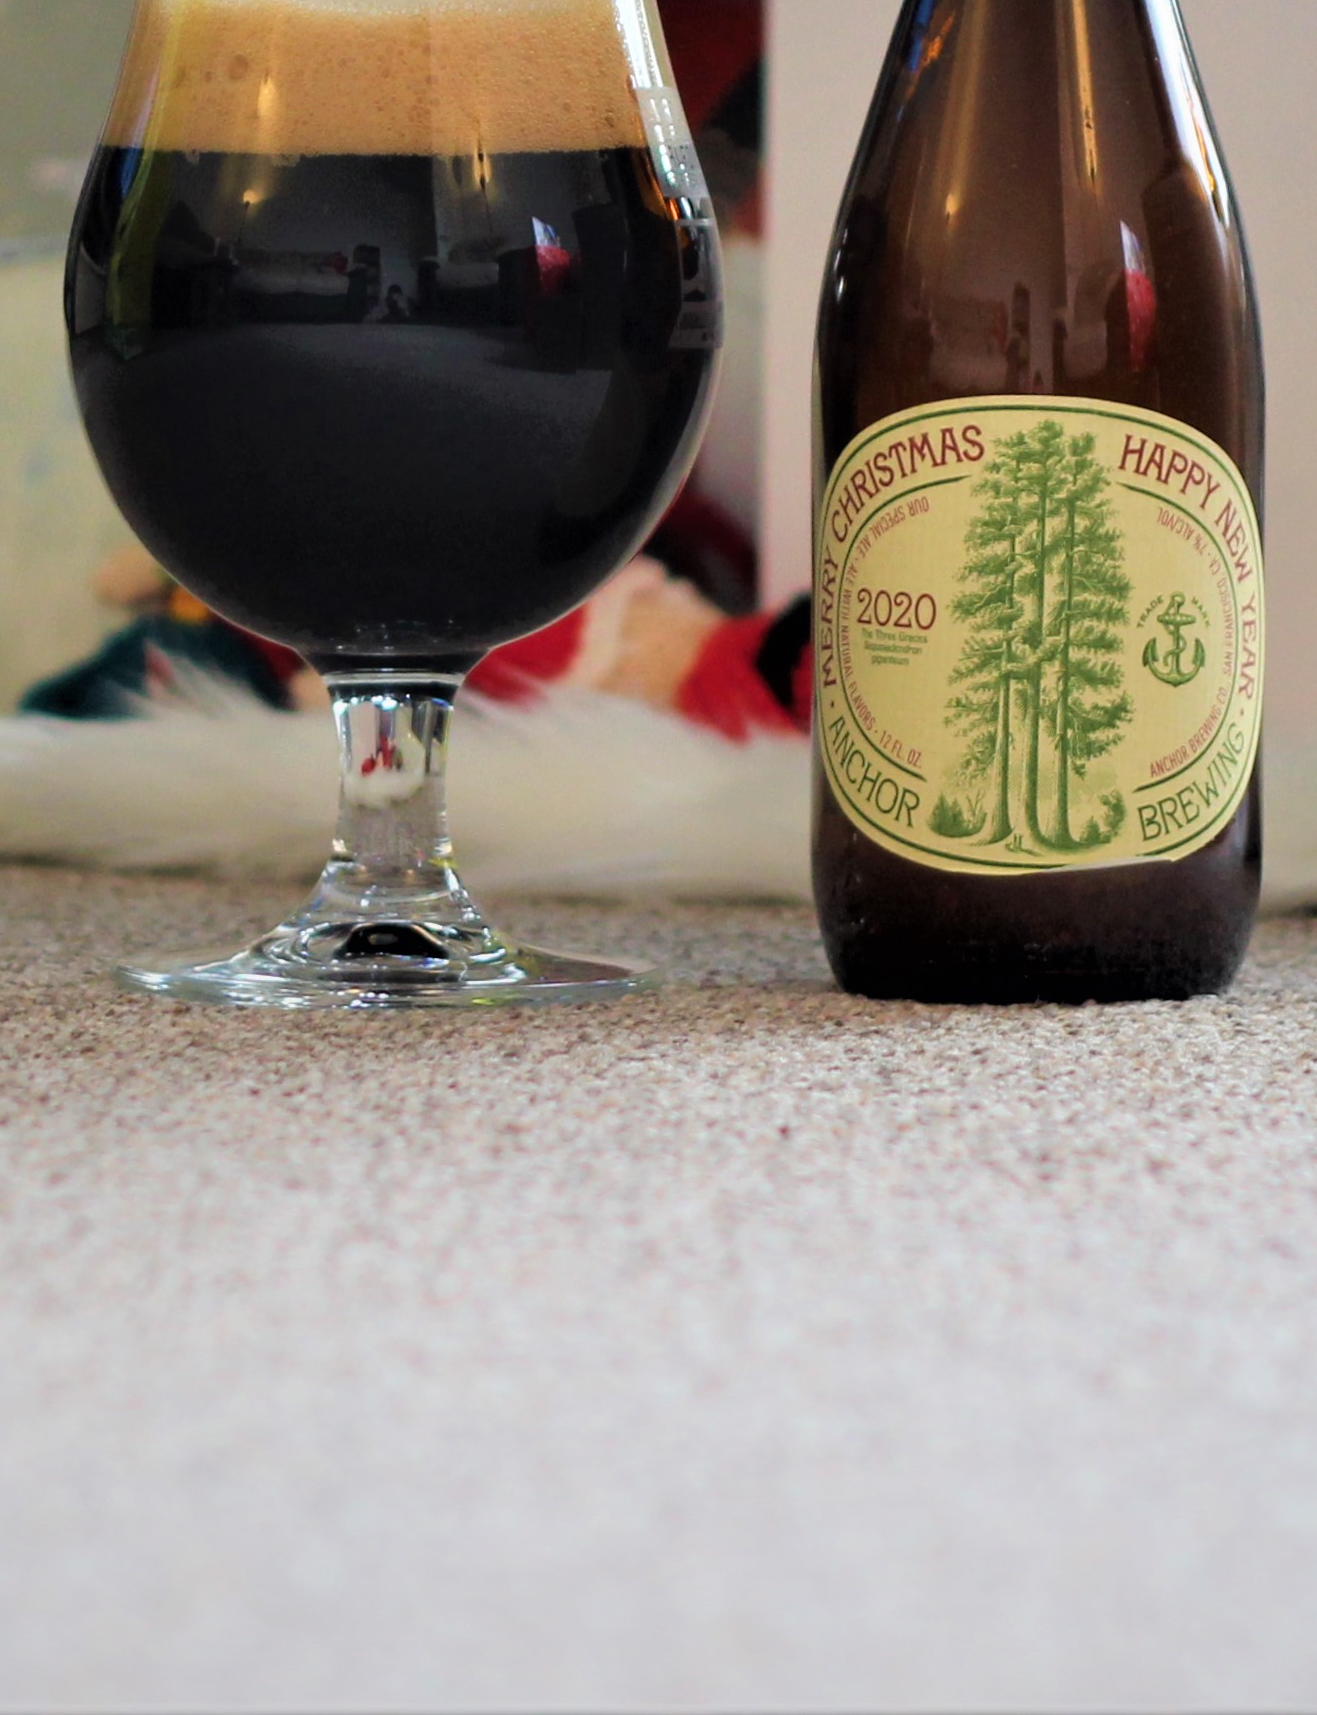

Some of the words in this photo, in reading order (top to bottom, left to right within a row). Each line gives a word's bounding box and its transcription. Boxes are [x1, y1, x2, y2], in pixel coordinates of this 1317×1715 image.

[871, 507, 906, 540] SPECIAL
[907, 496, 930, 517] OUR
[1156, 506, 1195, 542] ALC/VOL
[821, 544, 839, 688] MERRY
[832, 424, 985, 543] CHRISTMAS
[858, 540, 872, 558] ALE
[1118, 433, 1221, 511] HAPPY
[1214, 497, 1254, 583] NEW
[1238, 589, 1257, 700] YEAR
[857, 588, 937, 630] 2020
[1136, 594, 1165, 629] TRADE
[841, 625, 854, 680] NATURAL
[848, 681, 876, 731] FLAVORS
[1223, 651, 1234, 677] SAN
[879, 730, 892, 749] 12
[1150, 745, 1191, 778] ANCHOR
[1189, 704, 1222, 752] BREWING
[828, 715, 920, 829] ANCHOR
[1137, 721, 1245, 842] BREWING
